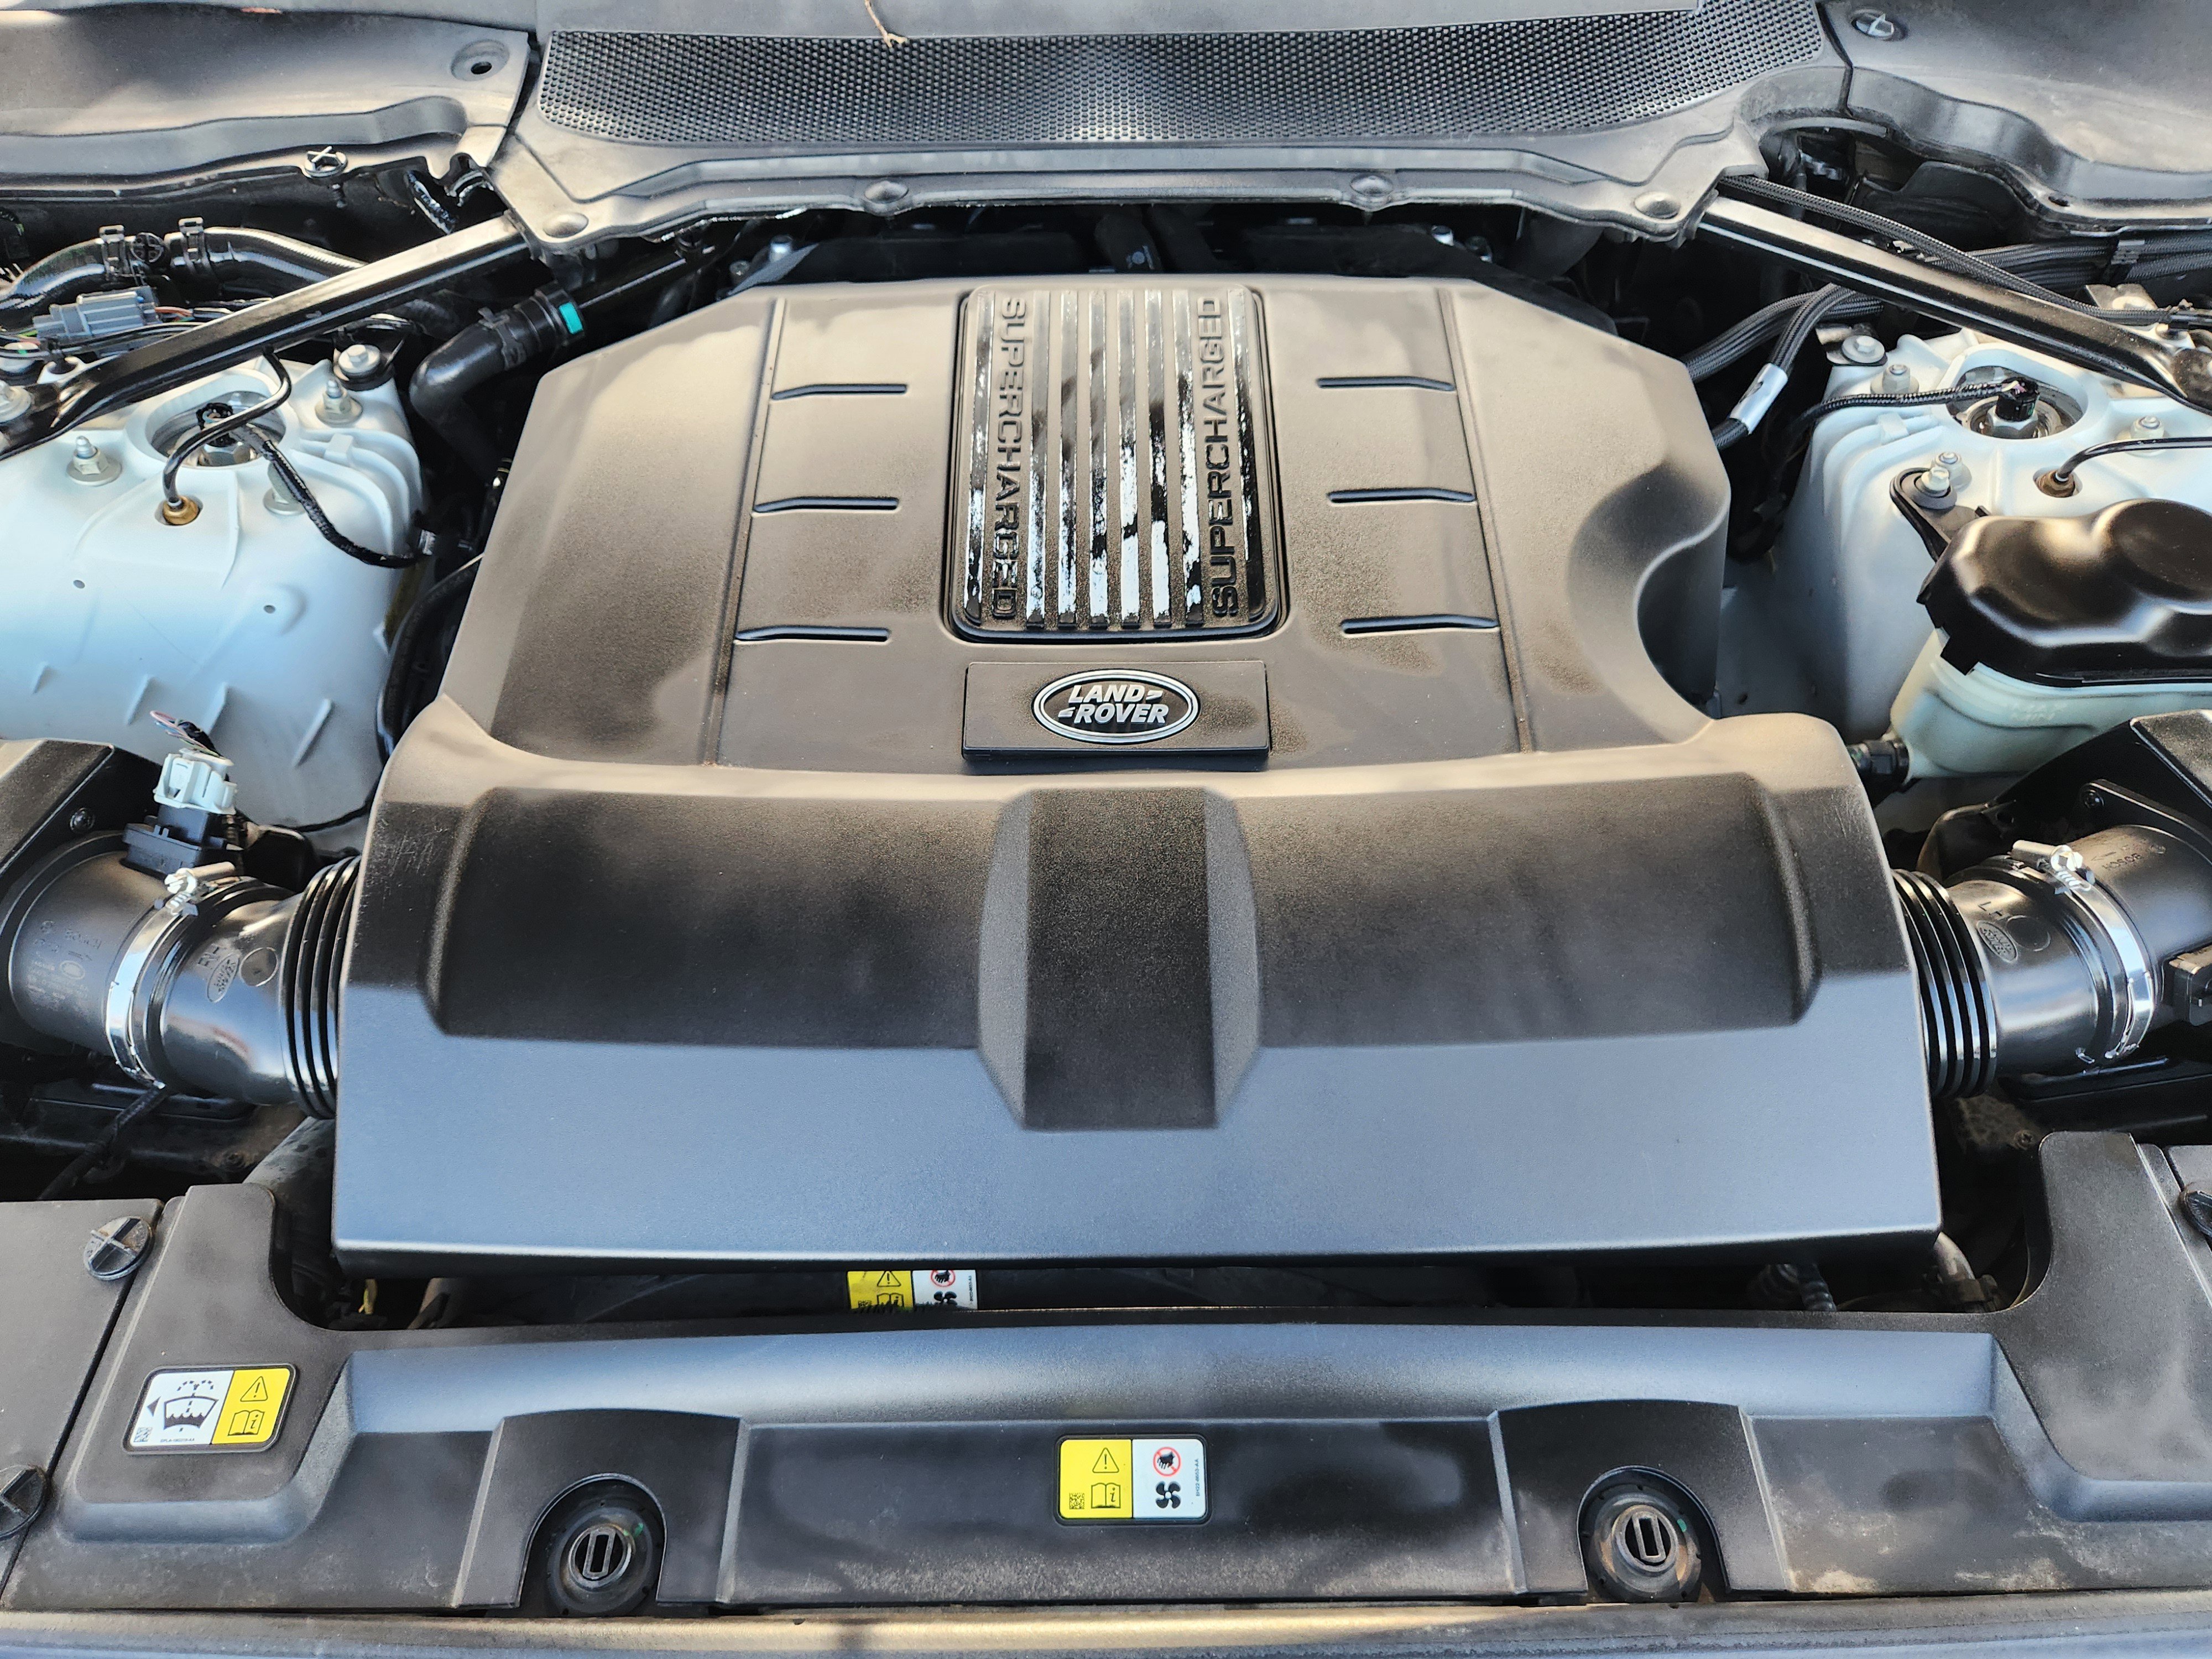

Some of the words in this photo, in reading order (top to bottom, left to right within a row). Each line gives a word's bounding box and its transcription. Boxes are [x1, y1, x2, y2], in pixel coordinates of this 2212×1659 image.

[992, 296, 1027, 619] SUPERCHARGED
[1197, 297, 1239, 618] SUPERCHARGED
[1068, 684, 1146, 704] LAND
[1073, 703, 1169, 724] ROVER
